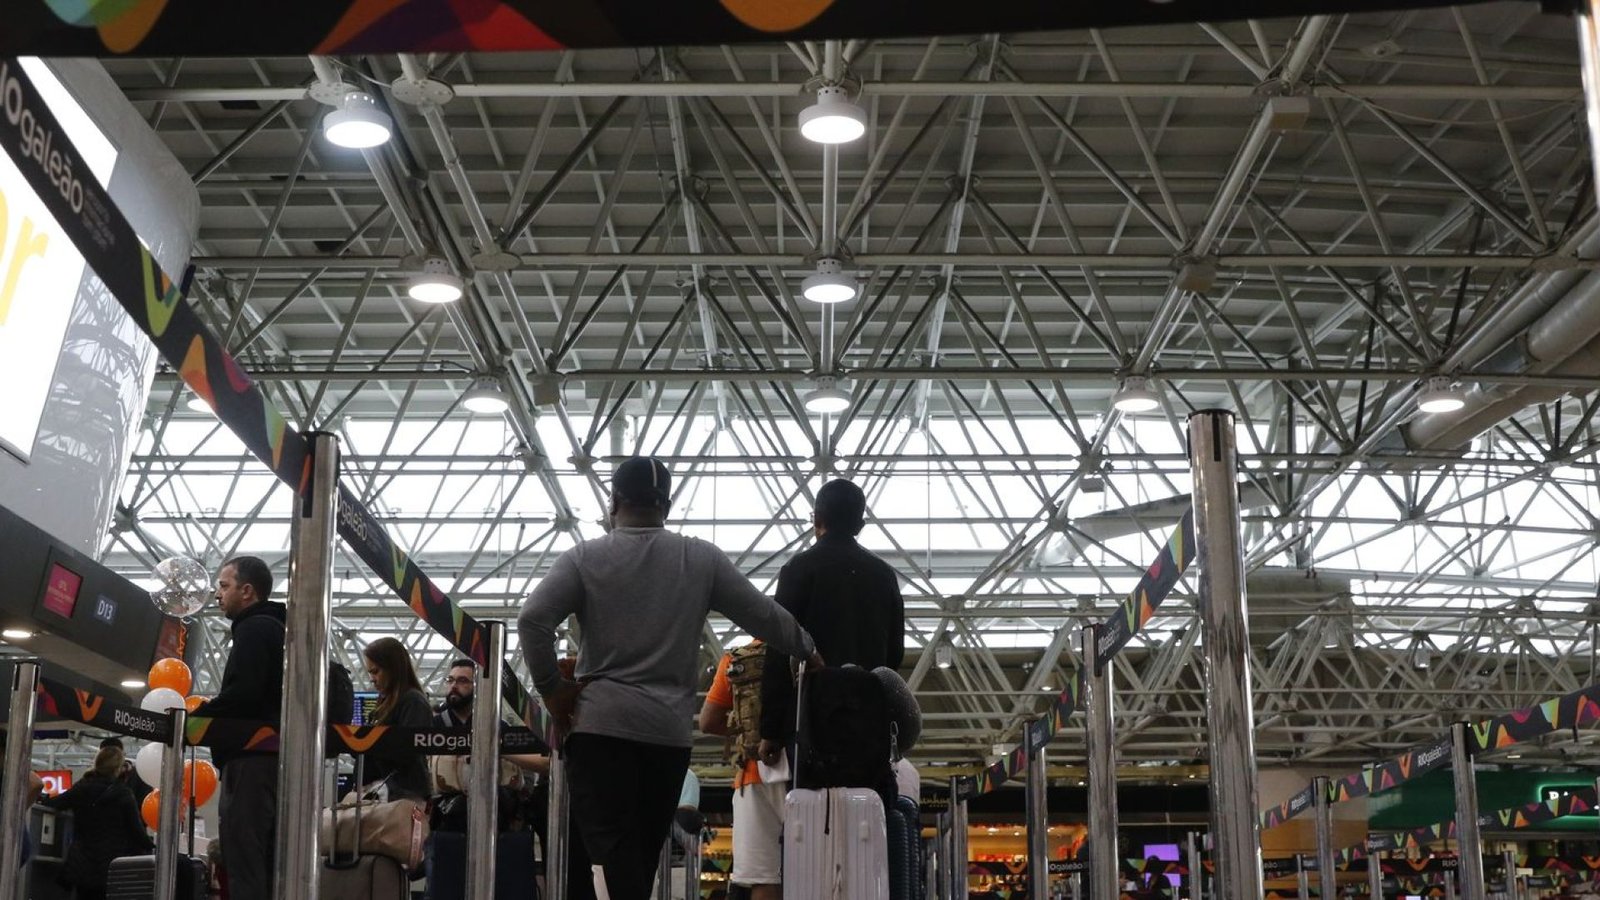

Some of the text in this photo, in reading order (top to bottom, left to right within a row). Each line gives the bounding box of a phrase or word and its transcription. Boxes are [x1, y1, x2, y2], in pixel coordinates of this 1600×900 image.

[97, 600, 113, 620] D13
[114, 709, 156, 733] RIOgaleão
[414, 733, 502, 750] RIOgal
